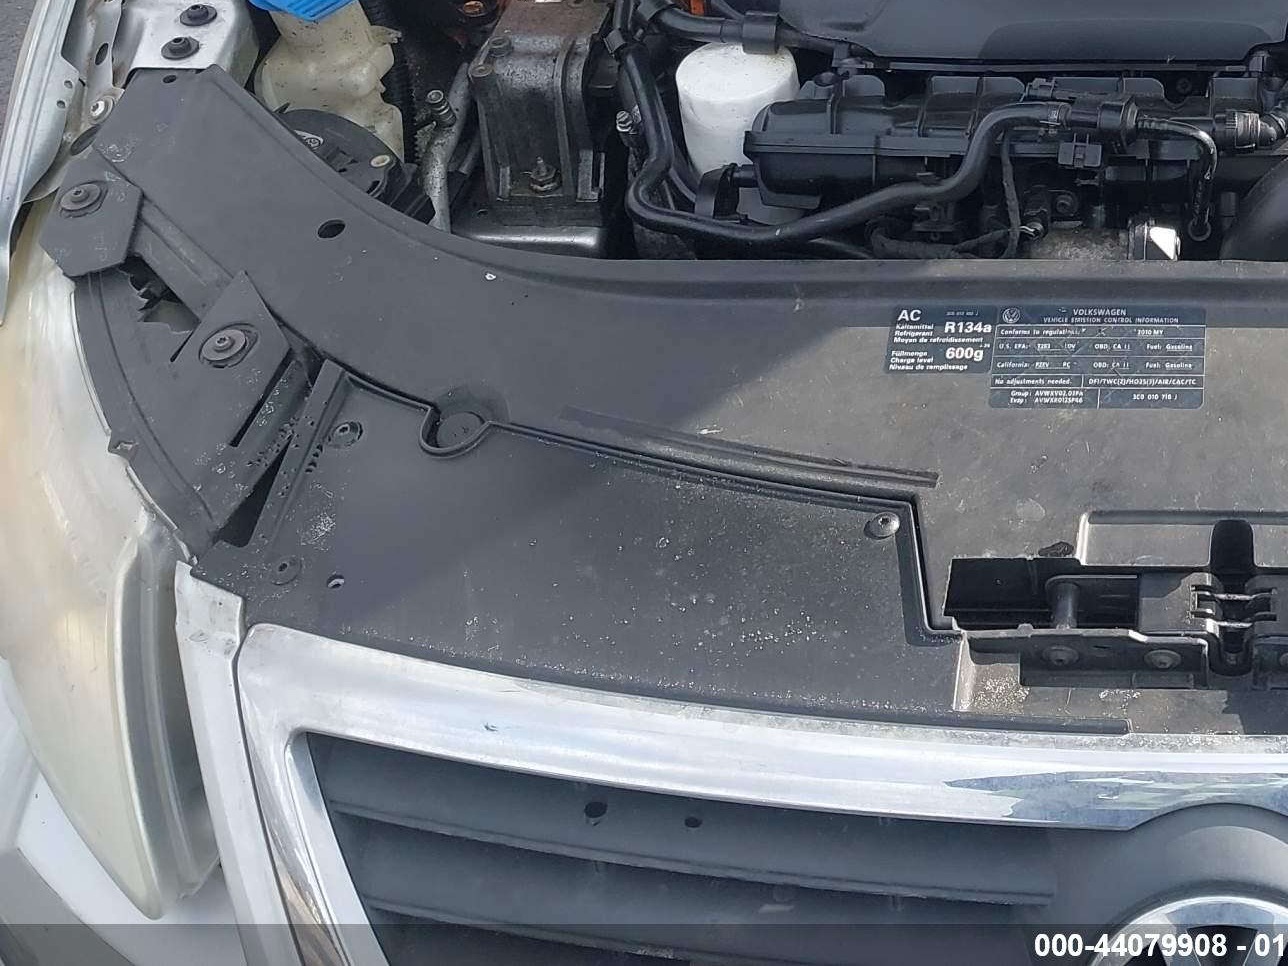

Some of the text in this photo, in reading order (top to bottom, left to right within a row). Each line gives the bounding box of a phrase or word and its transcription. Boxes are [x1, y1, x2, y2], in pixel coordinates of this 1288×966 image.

[897, 309, 922, 322] AC
[1073, 308, 1126, 316] VOLKSWAGEN
[944, 321, 992, 334] R134a
[917, 355, 934, 363] level
[945, 347, 984, 362] 600g
[1006, 378, 1044, 386] adjustments
